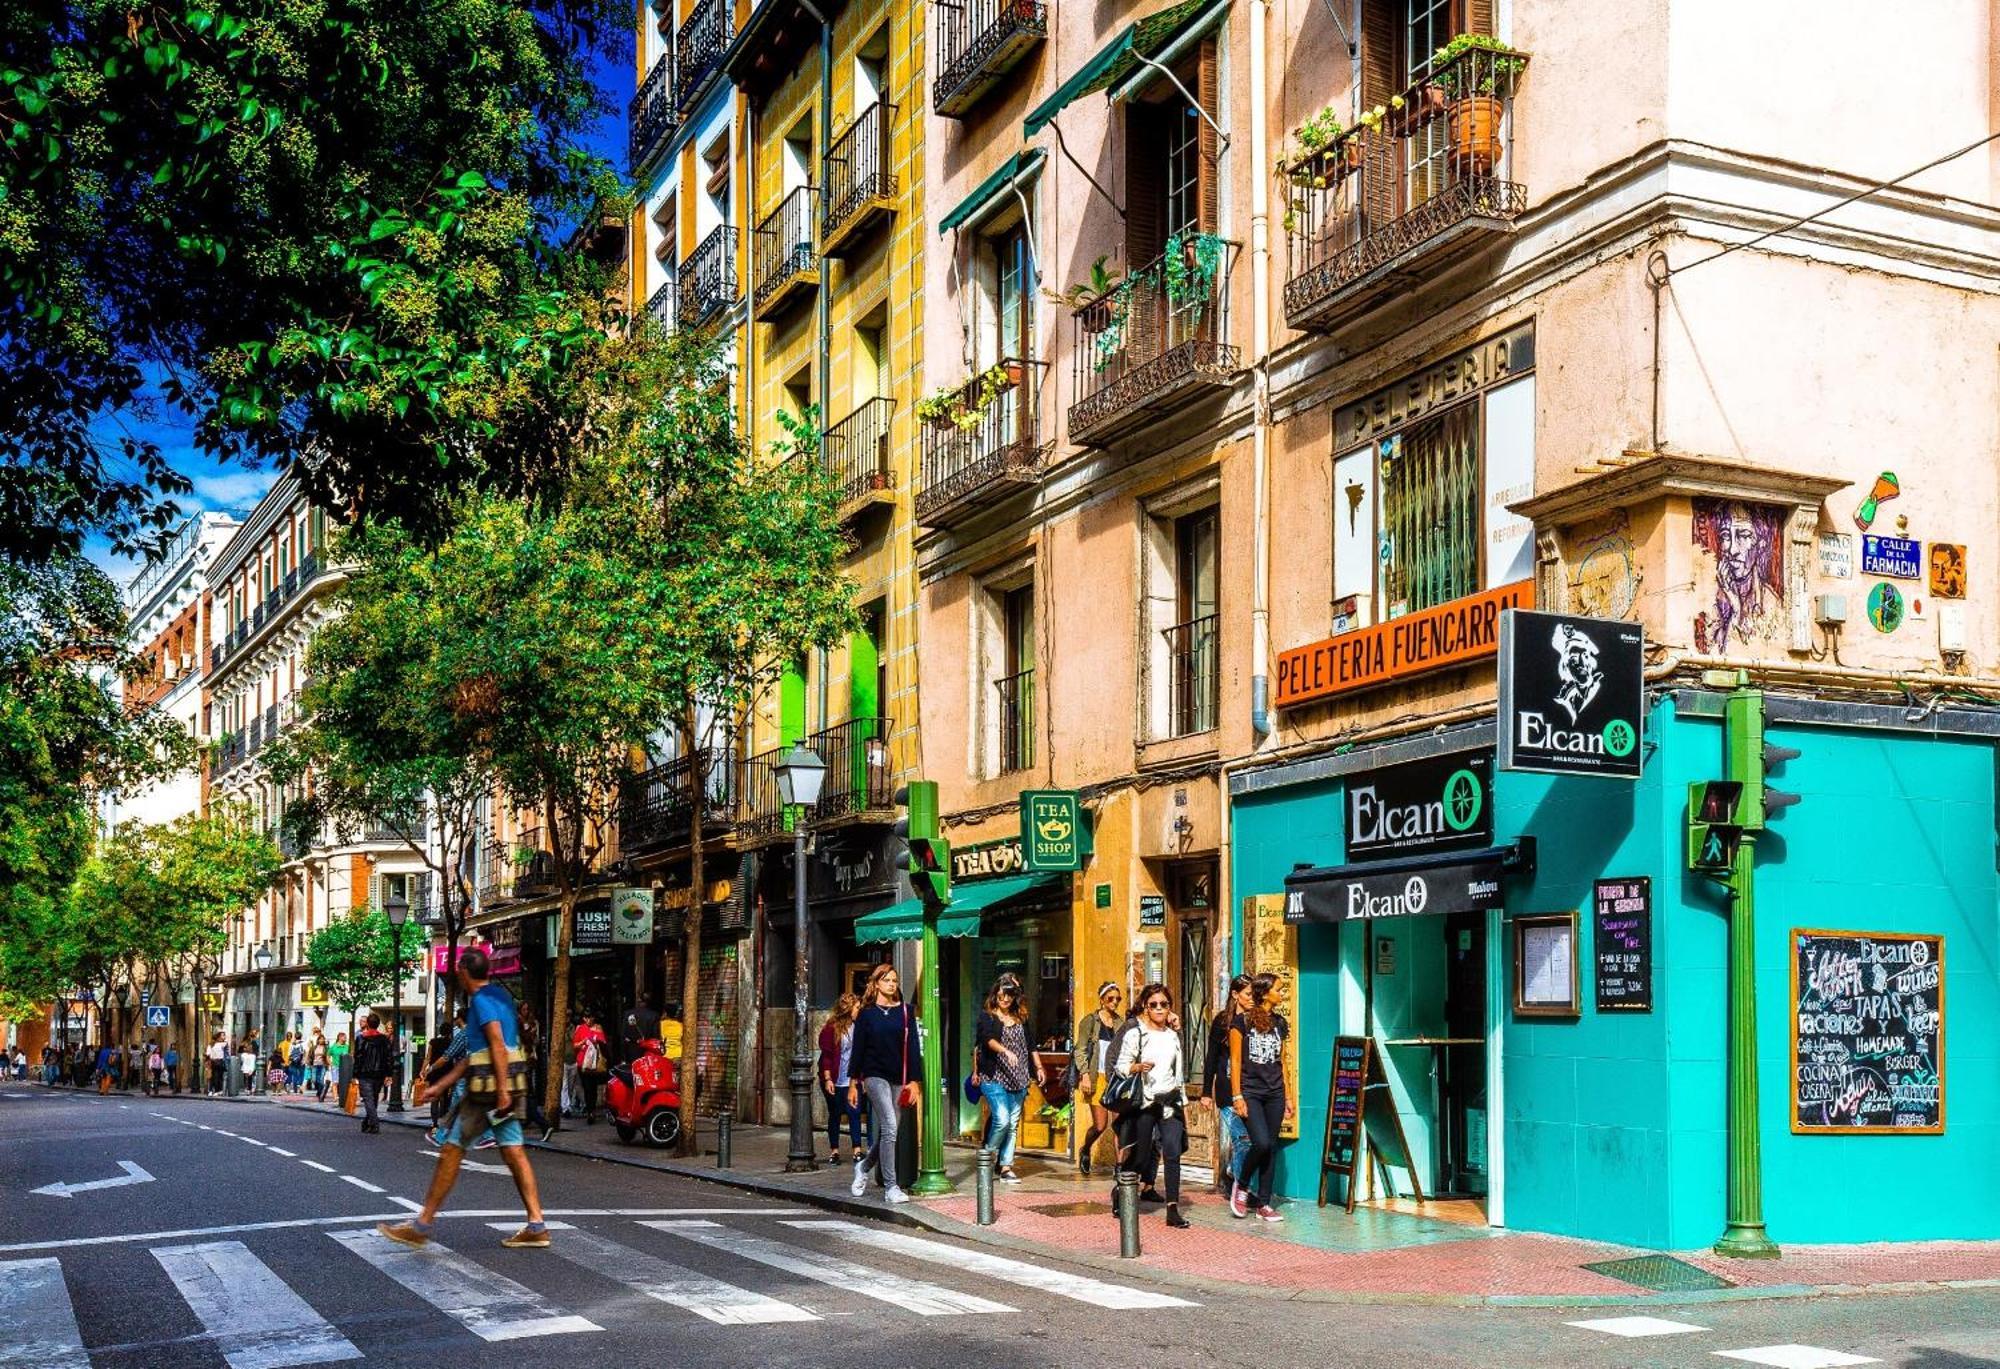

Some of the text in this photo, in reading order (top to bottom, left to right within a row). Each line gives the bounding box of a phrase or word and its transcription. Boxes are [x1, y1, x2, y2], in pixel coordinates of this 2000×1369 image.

[1353, 338, 1512, 442] PELETERIA
[1881, 539, 1912, 552] CALLE
[1865, 555, 1918, 577] FARMACIA
[1278, 592, 1519, 698] PELETERIA FUENCARR
[1035, 803, 1071, 817] TEA
[1037, 842, 1072, 854] SHOP
[954, 850, 991, 877] TEA
[577, 912, 611, 922] LUSH
[1854, 992, 1901, 1020] TAPAS
[1799, 1011, 1864, 1035] raciones
[1797, 1065, 1840, 1082] COCINA
